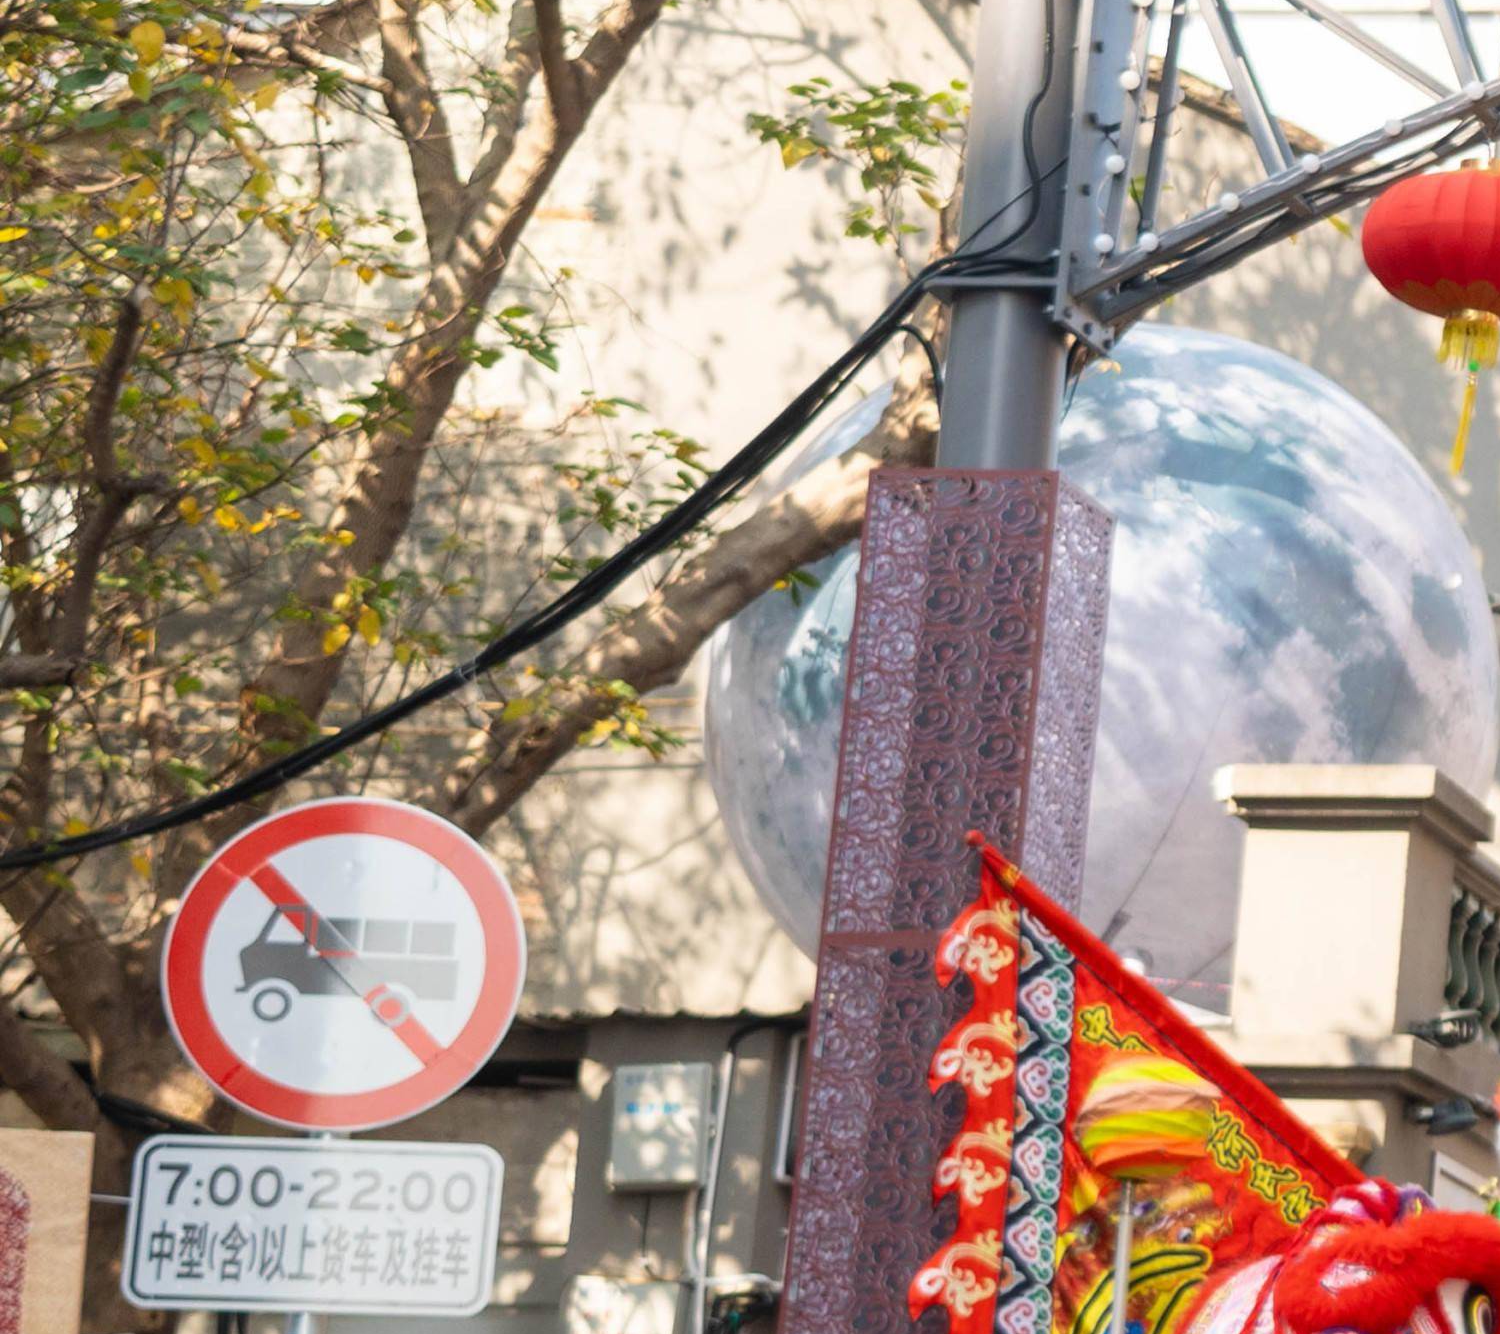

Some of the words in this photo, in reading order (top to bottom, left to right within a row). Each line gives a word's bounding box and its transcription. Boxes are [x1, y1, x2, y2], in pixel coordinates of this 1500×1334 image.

[157, 1162, 478, 1216] 7:00-22:00
[149, 1220, 472, 1289] 中型(含)以上货车及挂车
